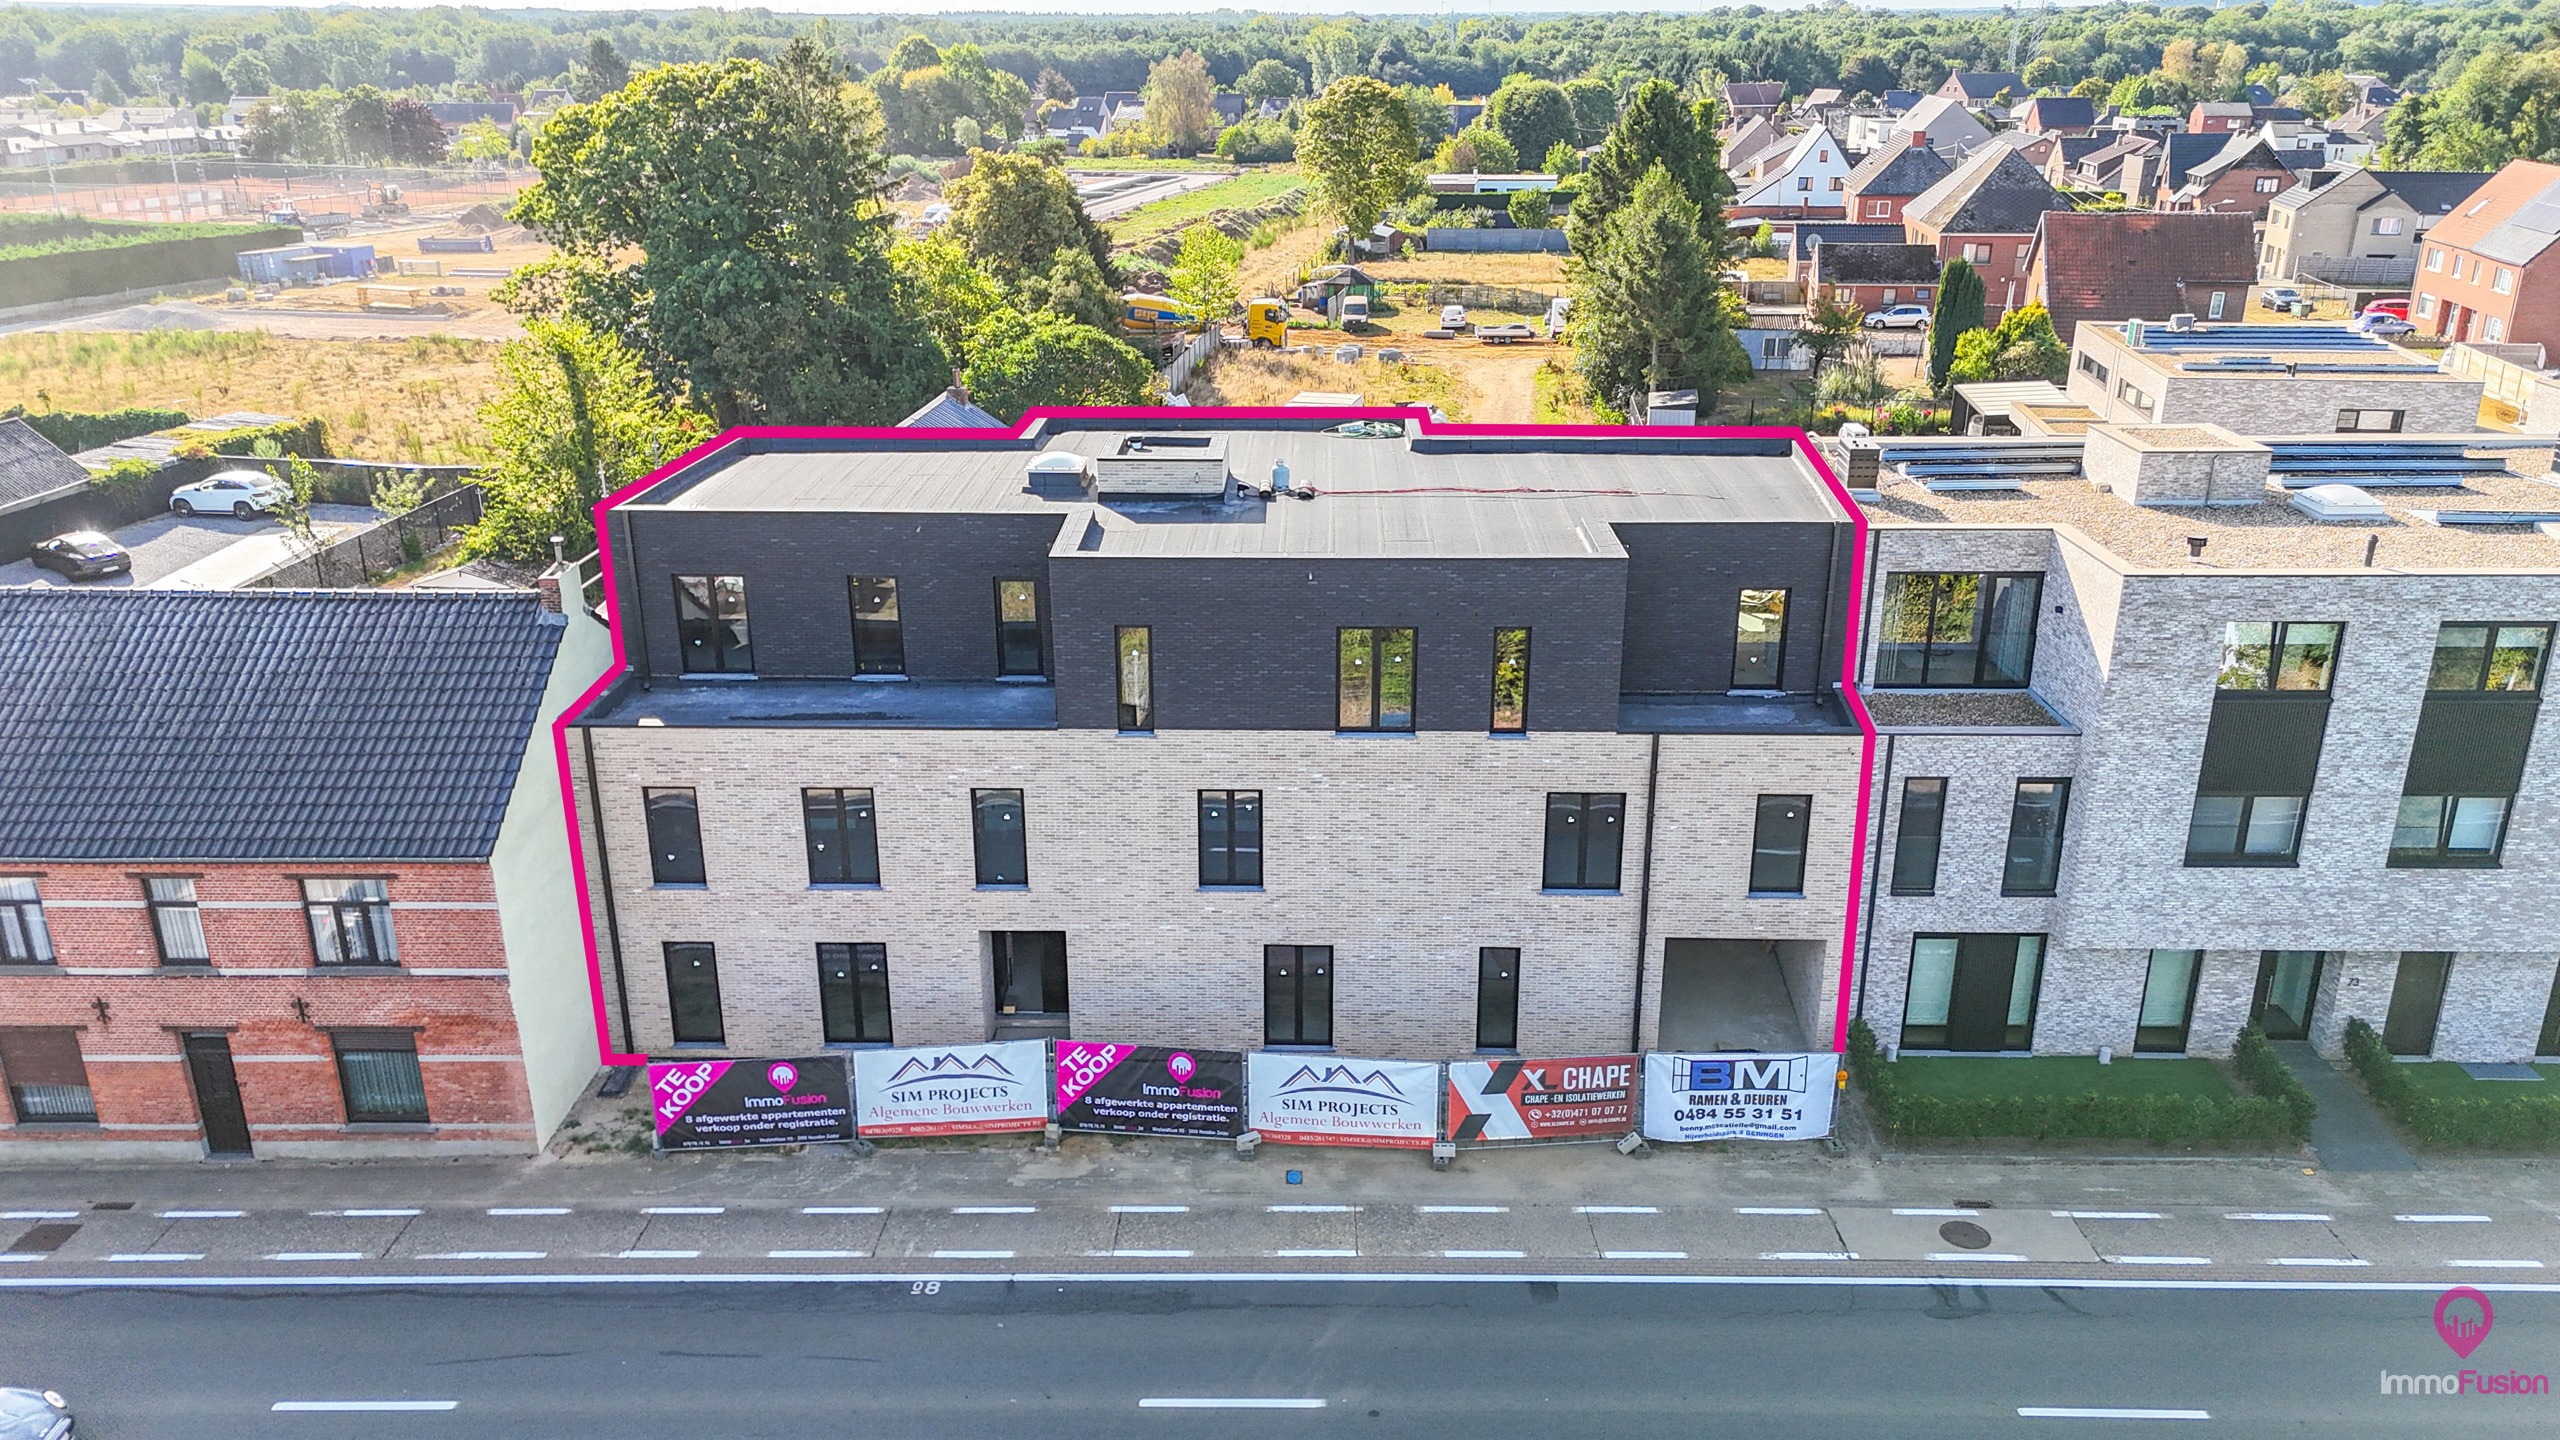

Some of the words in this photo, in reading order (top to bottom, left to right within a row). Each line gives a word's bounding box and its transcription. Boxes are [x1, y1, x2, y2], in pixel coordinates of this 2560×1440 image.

[2347, 977, 2360, 986] 73
[1060, 1045, 1092, 1072] TE
[654, 1066, 687, 1094] TE
[1061, 1044, 1117, 1098] KOOP
[1522, 1068, 1559, 1091] XL
[1563, 1064, 1631, 1090] CHAPE
[1691, 1061, 1790, 1090] BM
[658, 1062, 713, 1120] KOOP
[891, 1091, 922, 1104] SIM
[929, 1086, 1009, 1103] PROJECTS
[1142, 1082, 1222, 1099] ImmoFusion
[1524, 1094, 1549, 1104] CHAPE
[1565, 1090, 1626, 1102] ISOLATIEWERKEN
[1688, 1094, 1728, 1106] RAMEN
[1730, 1093, 1741, 1106] &
[1743, 1094, 1788, 1106] DEUREN
[744, 1093, 827, 1108] ImmoFusion
[1085, 1096, 1092, 1104] 8
[1094, 1097, 1154, 1109] afgewerkte
[1156, 1101, 1238, 1114] appartementen
[1282, 1099, 1312, 1112] SIM
[1318, 1101, 1398, 1117] PROJECTS
[696, 1113, 759, 1126] afgewerkte
[761, 1107, 846, 1122] appartementen
[869, 1105, 938, 1122] Algemene
[943, 1100, 1033, 1115] Bouwwerken
[1093, 1108, 1136, 1119] verkoop
[1138, 1110, 1170, 1119] onder
[1171, 1112, 1230, 1123] registratie.
[1544, 1107, 1588, 1119] +32(0)471
[1591, 1107, 1601, 1116] 07
[1604, 1106, 1614, 1115] 07
[1617, 1105, 1628, 1114] 77
[1674, 1108, 1717, 1121] 0484
[1723, 1108, 1746, 1119] 55
[1752, 1109, 1773, 1119] 31
[1780, 1109, 1802, 1121] 51
[695, 1122, 740, 1134] verkoop
[743, 1121, 776, 1131] onder
[778, 1118, 839, 1130] registratie.
[1259, 1111, 1327, 1129] Algemene
[1332, 1116, 1422, 1131] Bouwwerken
